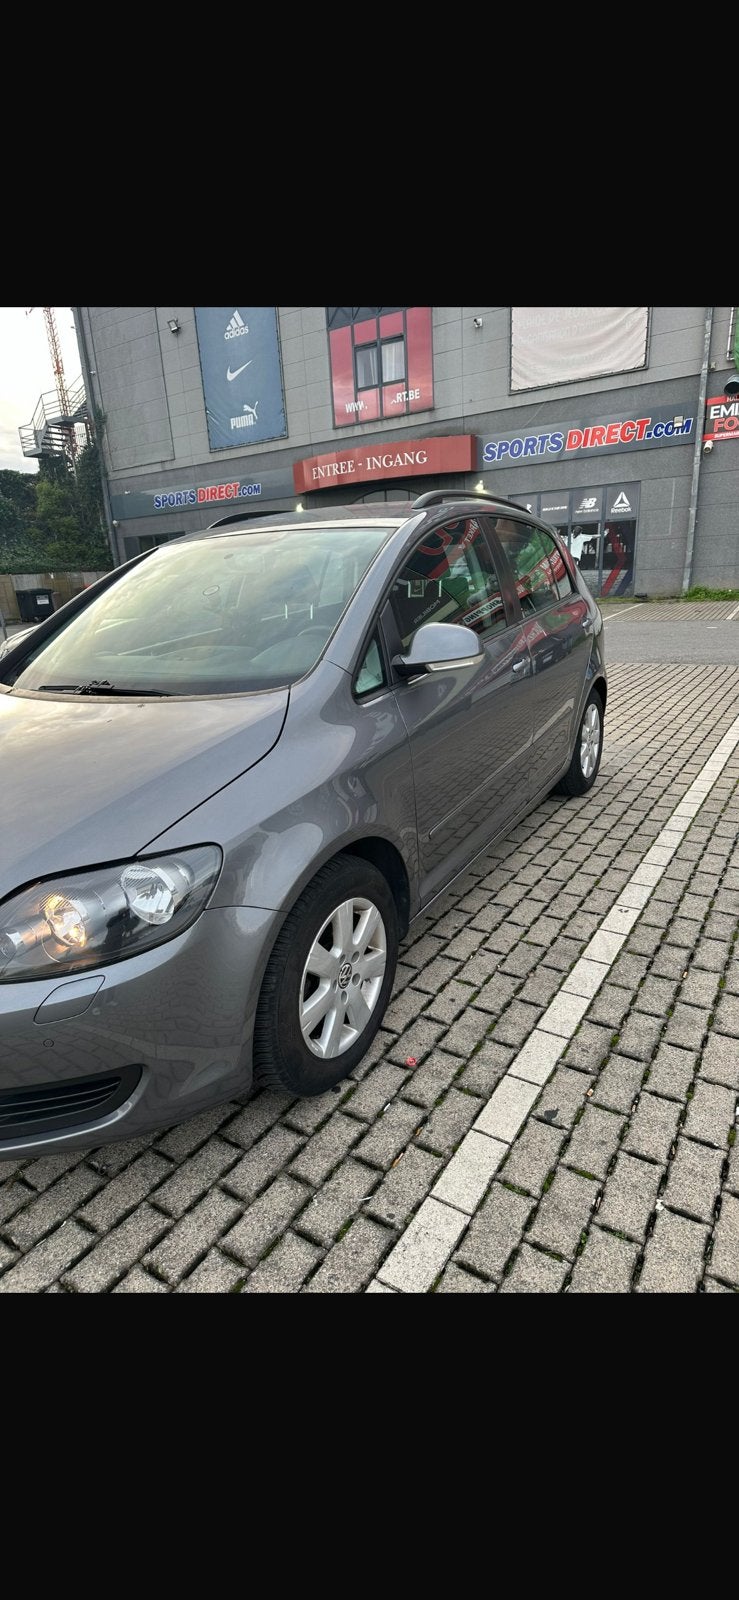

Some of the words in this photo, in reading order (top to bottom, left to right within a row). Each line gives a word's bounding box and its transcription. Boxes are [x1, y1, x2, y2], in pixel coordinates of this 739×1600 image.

[224, 326, 249, 340] adidas
[230, 413, 255, 430] PUMA
[713, 416, 739, 432] FO
[483, 432, 564, 462] SPORTS
[312, 459, 355, 480] ENTREE
[366, 450, 429, 471] INGANG
[153, 489, 196, 509] SPORTS
